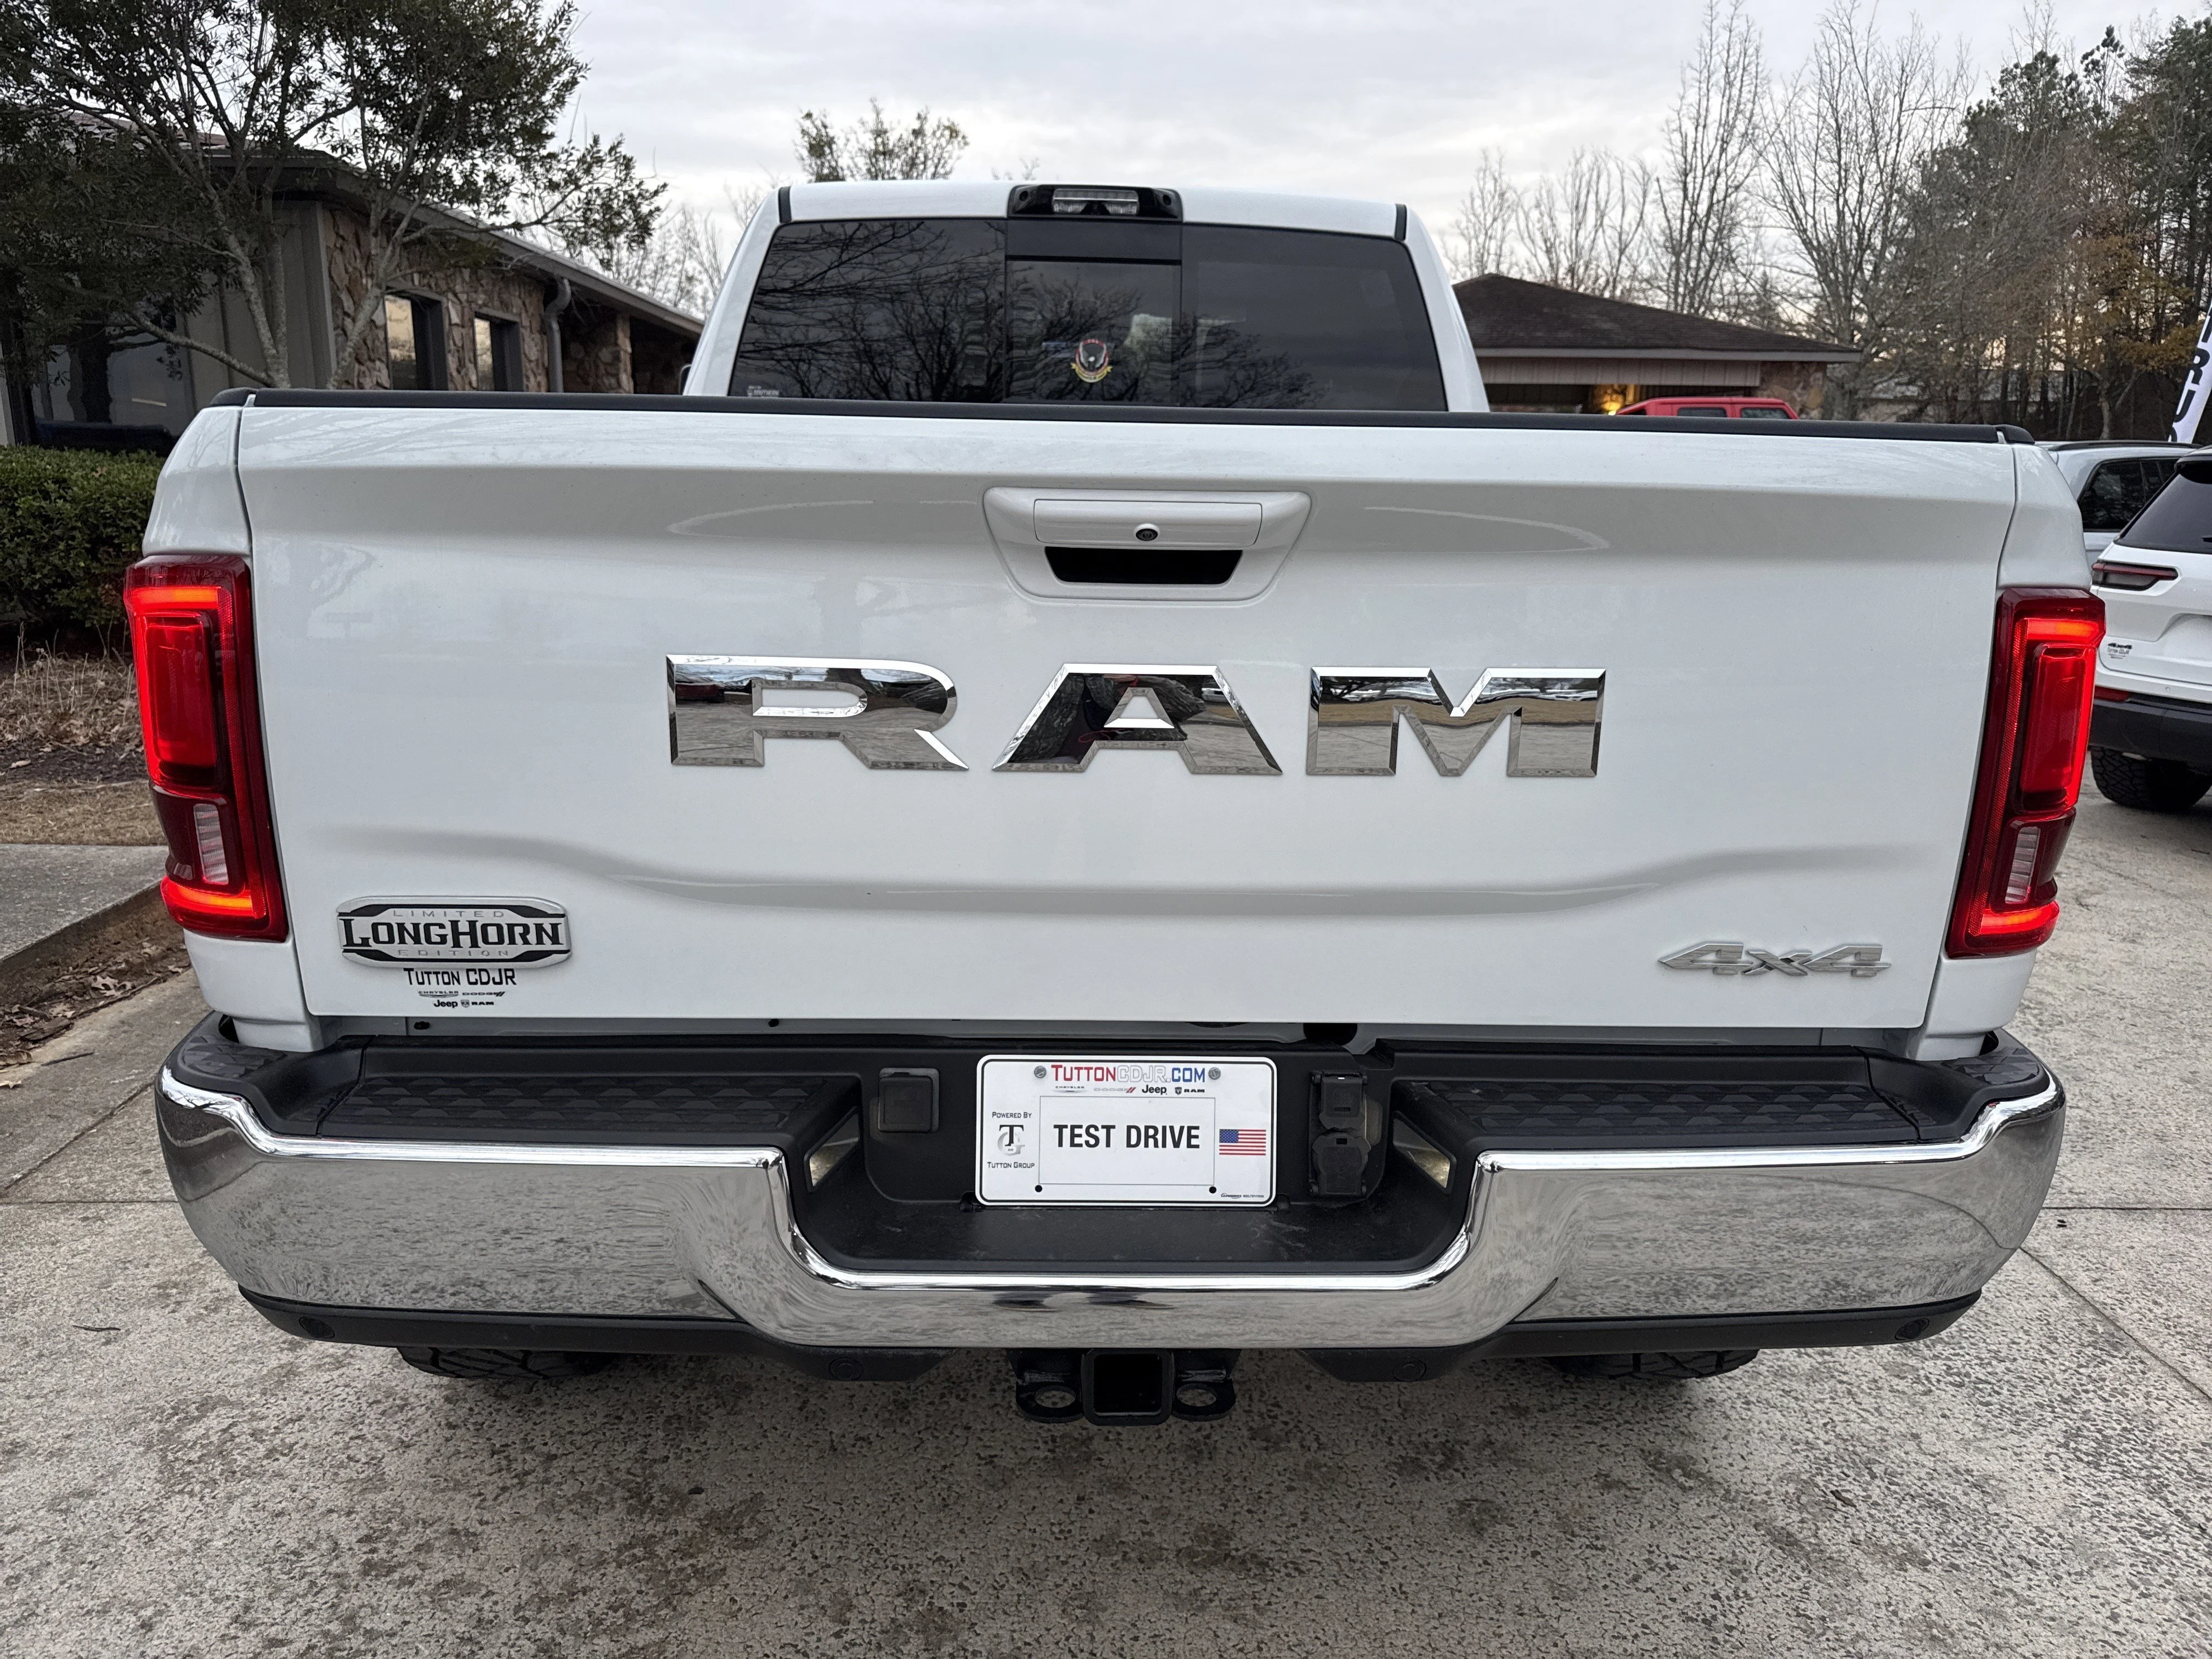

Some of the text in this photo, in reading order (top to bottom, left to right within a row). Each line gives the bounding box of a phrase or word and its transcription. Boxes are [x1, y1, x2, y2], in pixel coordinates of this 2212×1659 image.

[665, 653, 1606, 777] RAM
[393, 910, 504, 918] LIMITED
[340, 918, 563, 949] LONGHORN
[403, 968, 517, 986] TUTTON CDJR
[433, 1000, 458, 1008] Jeep
[1142, 1084, 1167, 1095] Jeep
[1053, 1124, 1200, 1149] TEST DRIVE
